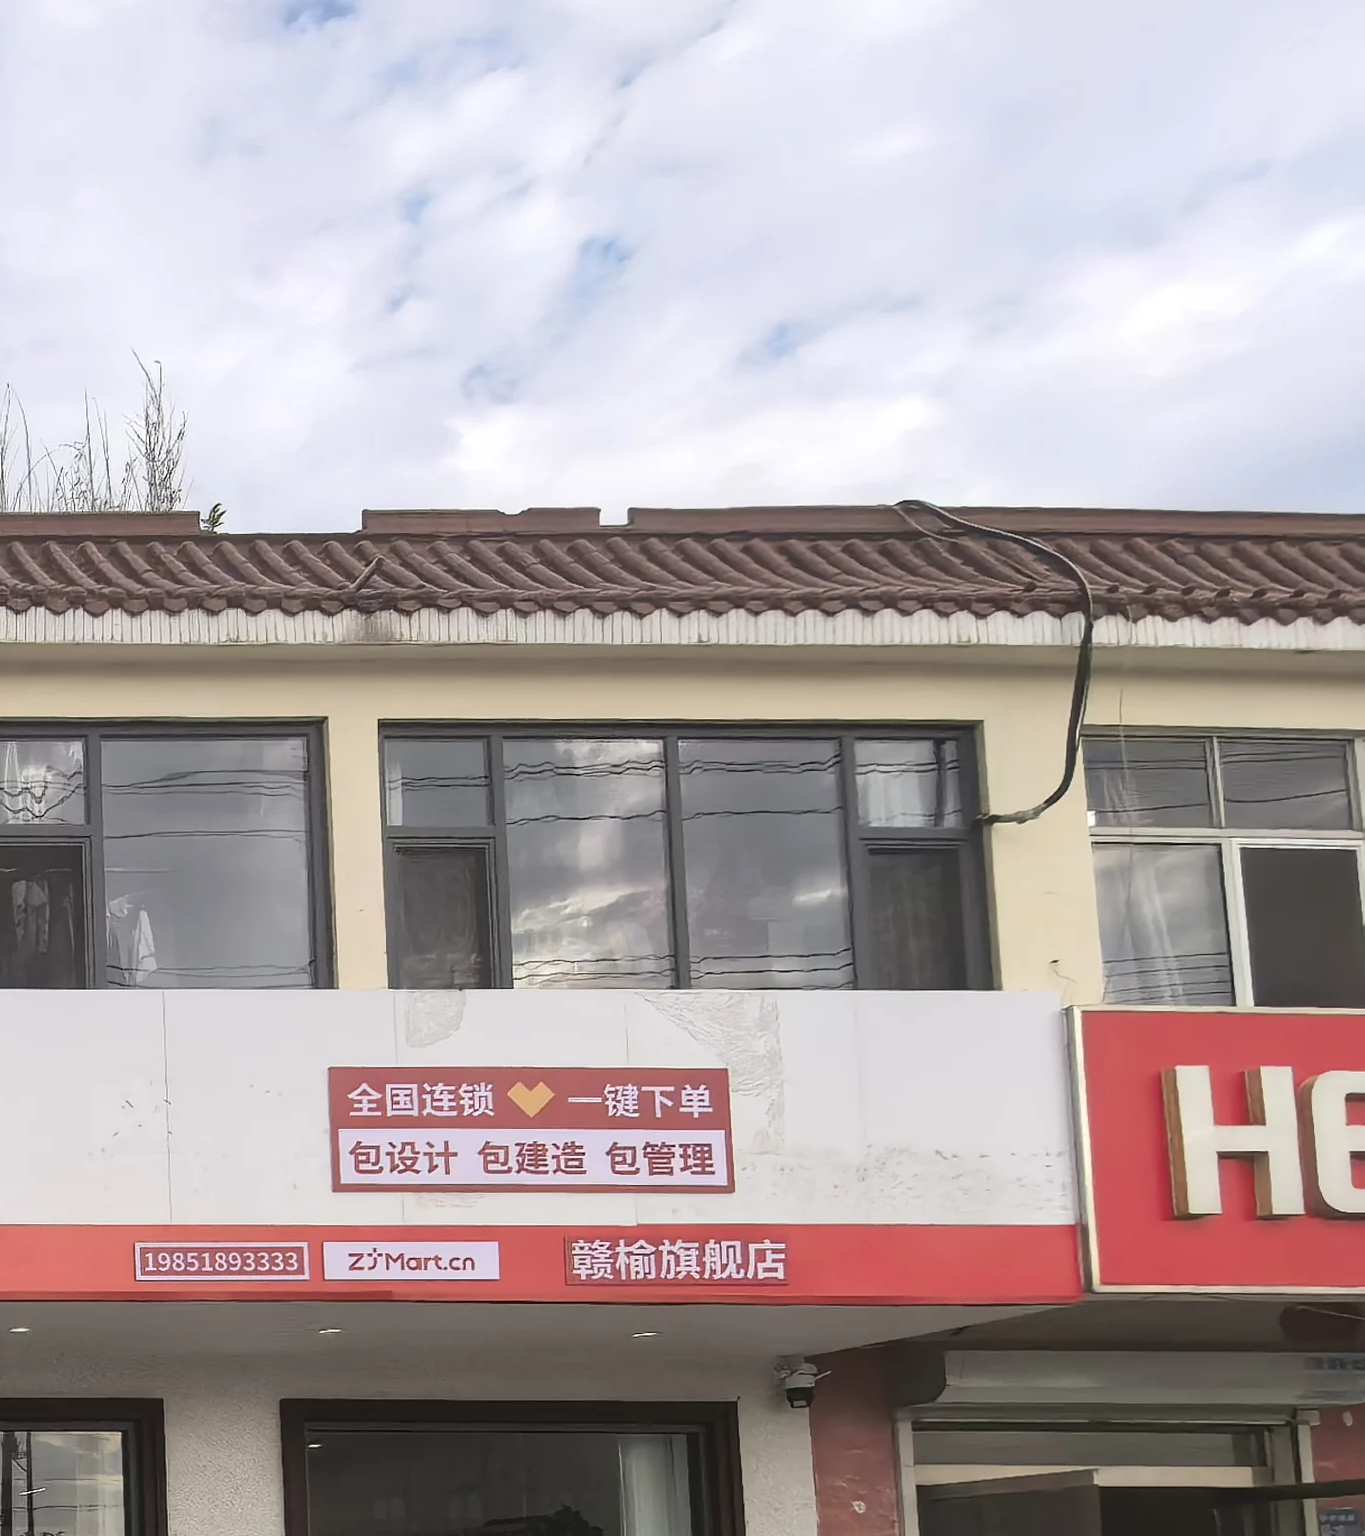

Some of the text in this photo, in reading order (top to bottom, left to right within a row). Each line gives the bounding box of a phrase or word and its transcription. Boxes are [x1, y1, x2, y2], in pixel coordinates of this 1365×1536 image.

[347, 1083, 713, 1118] 全国连锁 一键下单
[348, 1141, 716, 1176] 包设计 包建造 包管理
[144, 1252, 298, 1273] 19851893333
[571, 1240, 786, 1280] 赣榆旗舰店
